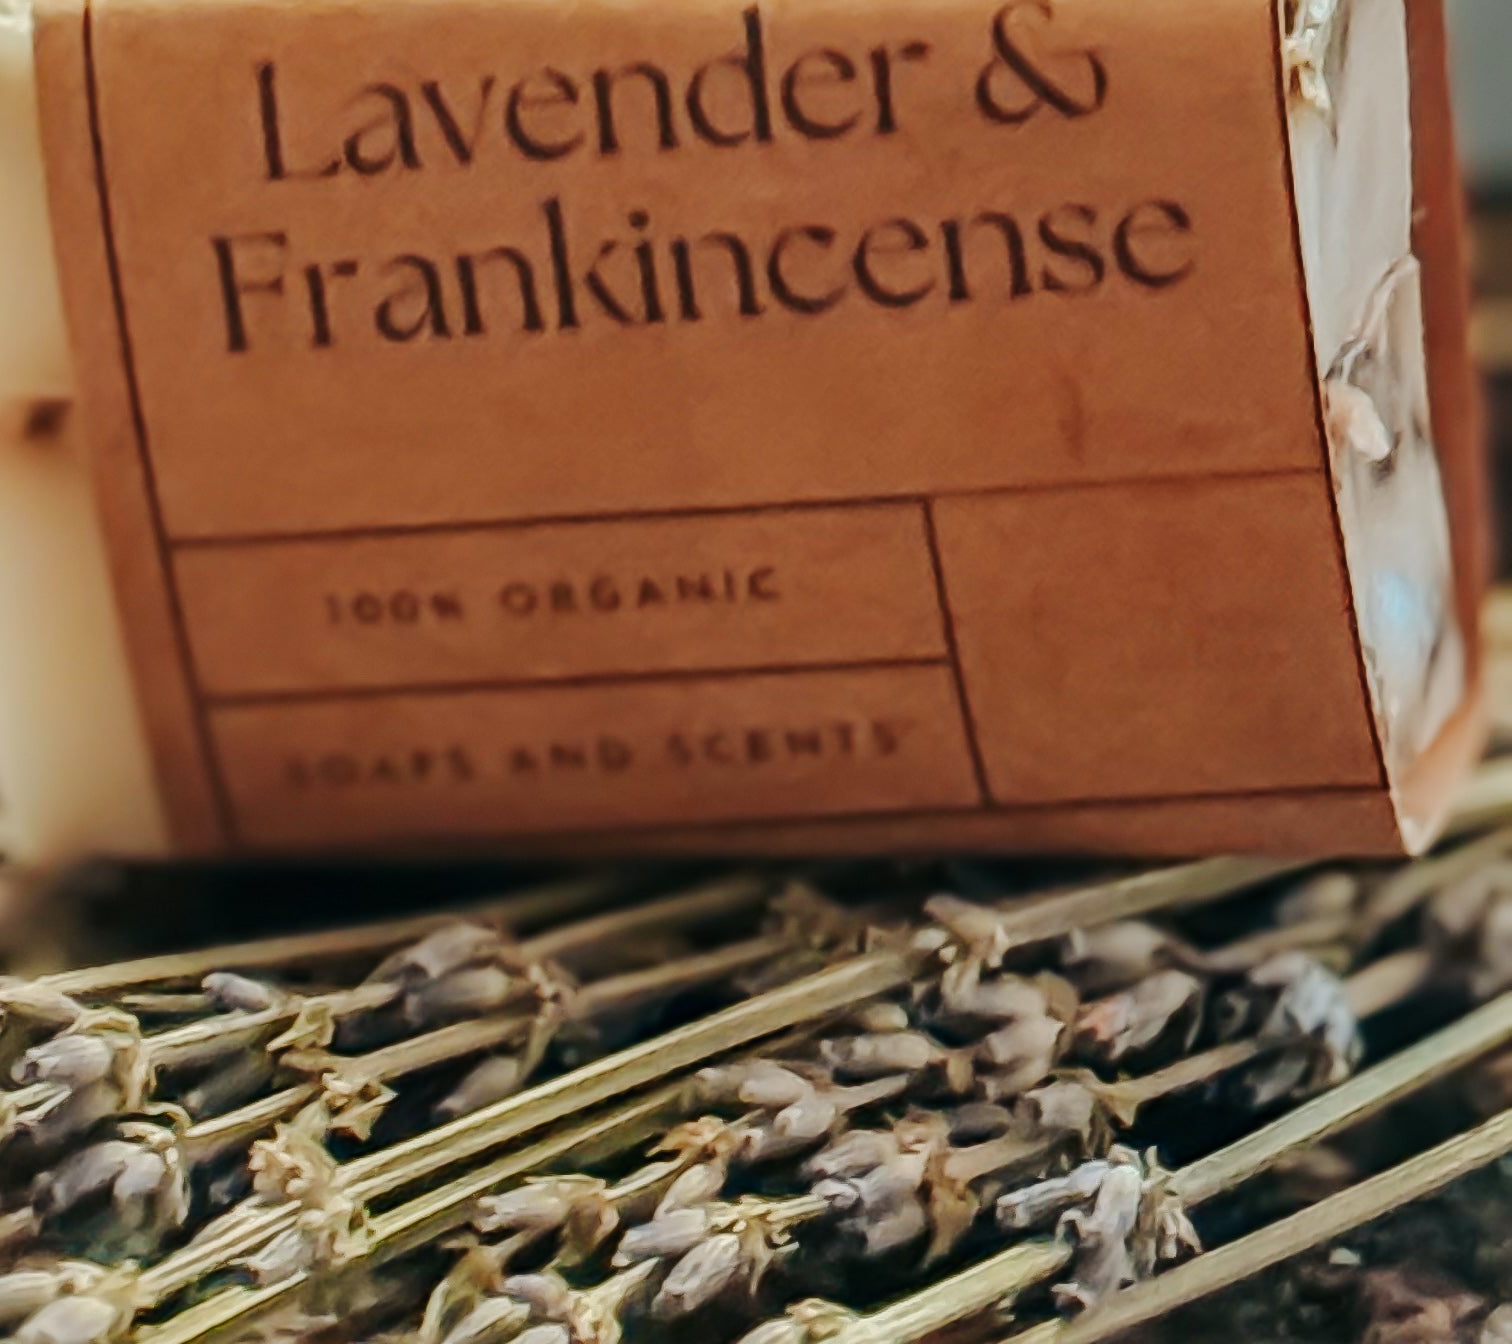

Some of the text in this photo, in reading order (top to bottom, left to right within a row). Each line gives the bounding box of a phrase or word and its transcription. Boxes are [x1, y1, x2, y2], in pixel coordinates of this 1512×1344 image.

[254, 3, 931, 182] Lavender
[209, 196, 1193, 354] Frankincense
[322, 565, 783, 628] 100% ORGANIC
[280, 718, 902, 792] SOAPS AND SCENTS
